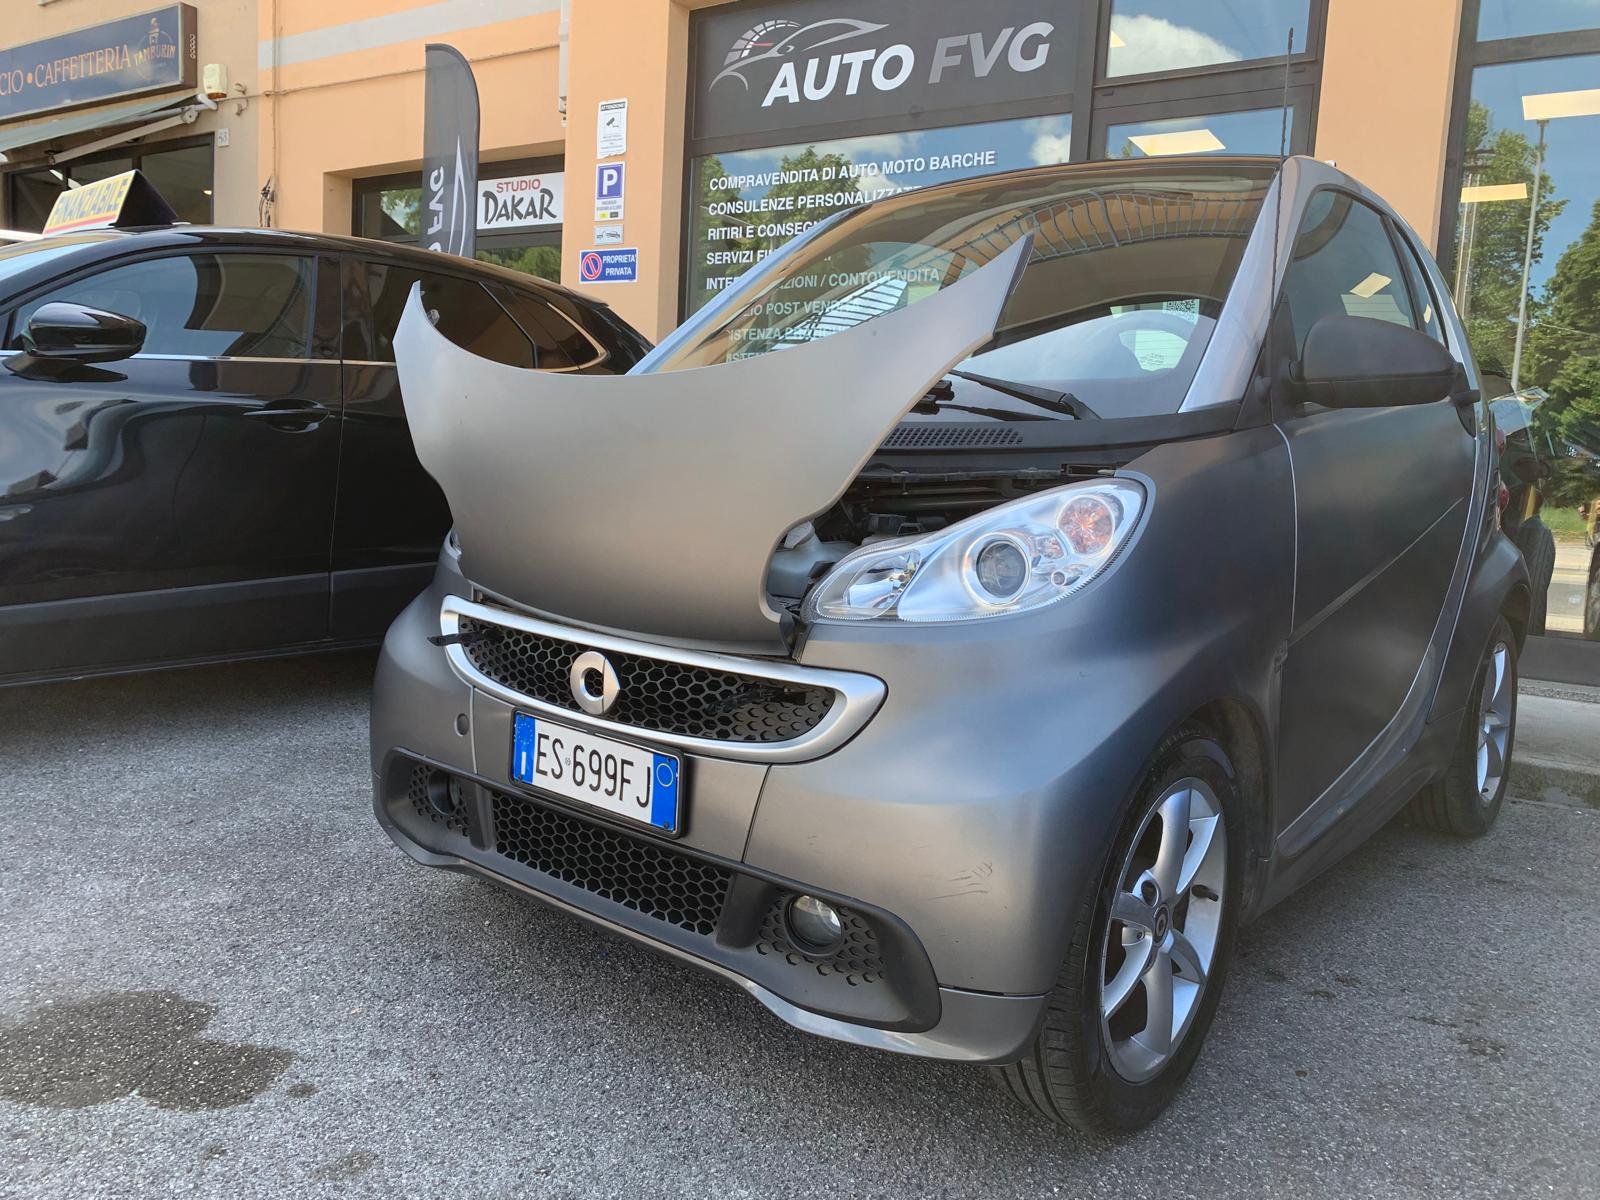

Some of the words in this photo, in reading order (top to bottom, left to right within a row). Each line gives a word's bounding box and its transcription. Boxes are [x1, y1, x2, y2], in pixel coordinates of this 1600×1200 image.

[34, 44, 131, 88] CAFFETTERIA
[761, 43, 914, 107] AUTO
[928, 22, 1054, 84] FVG
[602, 169, 618, 195] P
[709, 168, 819, 190] COMPRAVENDITA
[822, 167, 836, 180] DI
[839, 163, 878, 179] AUTO
[882, 158, 925, 174] MOTO
[930, 151, 996, 170] BARCHE
[496, 179, 541, 193] STUDIO
[427, 166, 444, 235] FVG
[482, 188, 557, 225] DAKAR
[708, 197, 795, 215] CONSULENZE
[797, 186, 924, 208] PERSONALIZZ
[708, 226, 743, 240] RITIRI
[746, 225, 755, 238] E
[706, 250, 753, 265] SERVIZI
[605, 267, 632, 276] PRIVATA
[766, 301, 801, 315] POST
